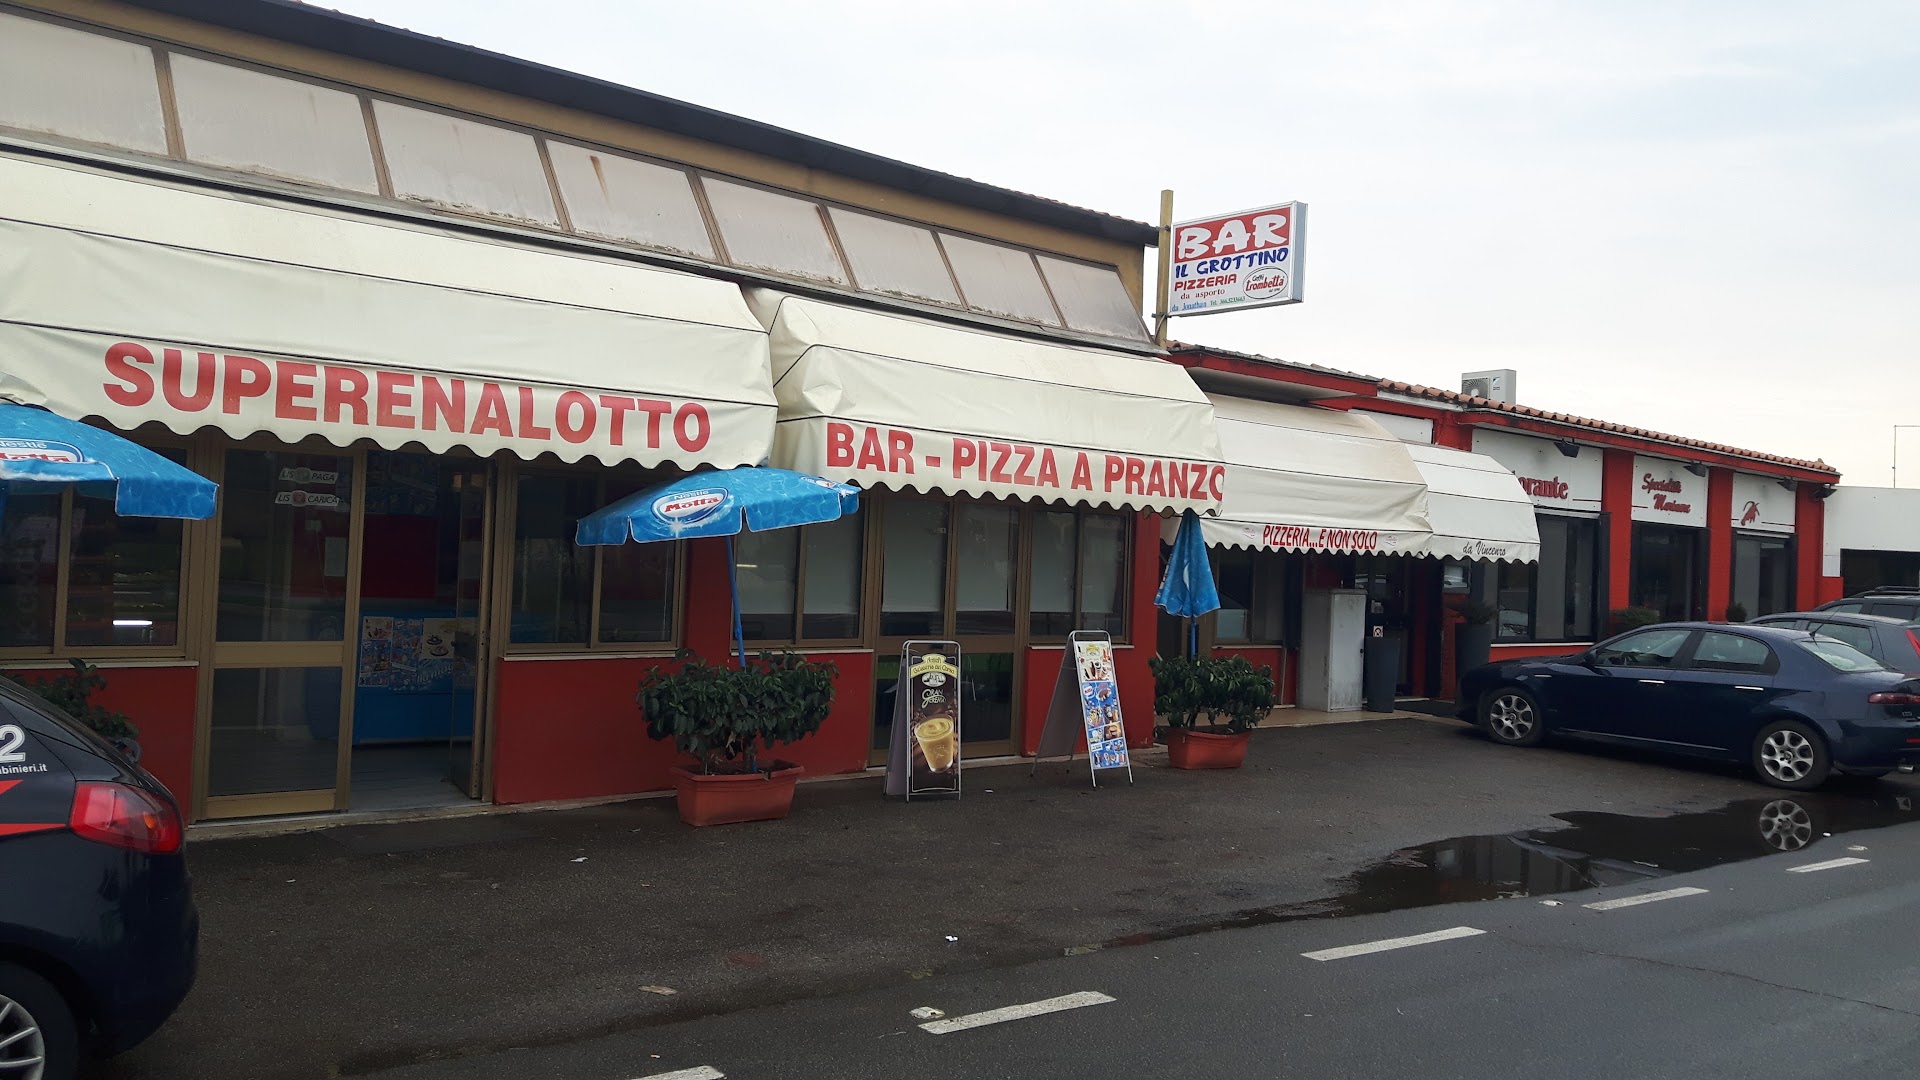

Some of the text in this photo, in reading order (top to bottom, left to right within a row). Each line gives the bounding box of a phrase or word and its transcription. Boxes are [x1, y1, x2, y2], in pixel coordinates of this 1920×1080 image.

[1178, 214, 1287, 259] BAR
[1175, 247, 1289, 278] IL GROTTINO
[1174, 273, 1237, 291] PIZZERIA
[1195, 289, 1225, 299] asporto
[1171, 304, 1179, 312] da
[103, 342, 711, 453] SUPERENALOTTO
[827, 422, 915, 474] BAR
[953, 437, 1060, 488] PIZZA
[1070, 451, 1093, 491] A
[1104, 454, 1226, 502] PRANZO
[312, 472, 335, 481] PAGA
[279, 494, 338, 504] LIS CARICA
[664, 497, 719, 512] Motta
[1327, 530, 1350, 549] NON
[1351, 531, 1378, 550] SOLO
[1463, 542, 1473, 554] da
[0, 764, 47, 774] binieri.it
